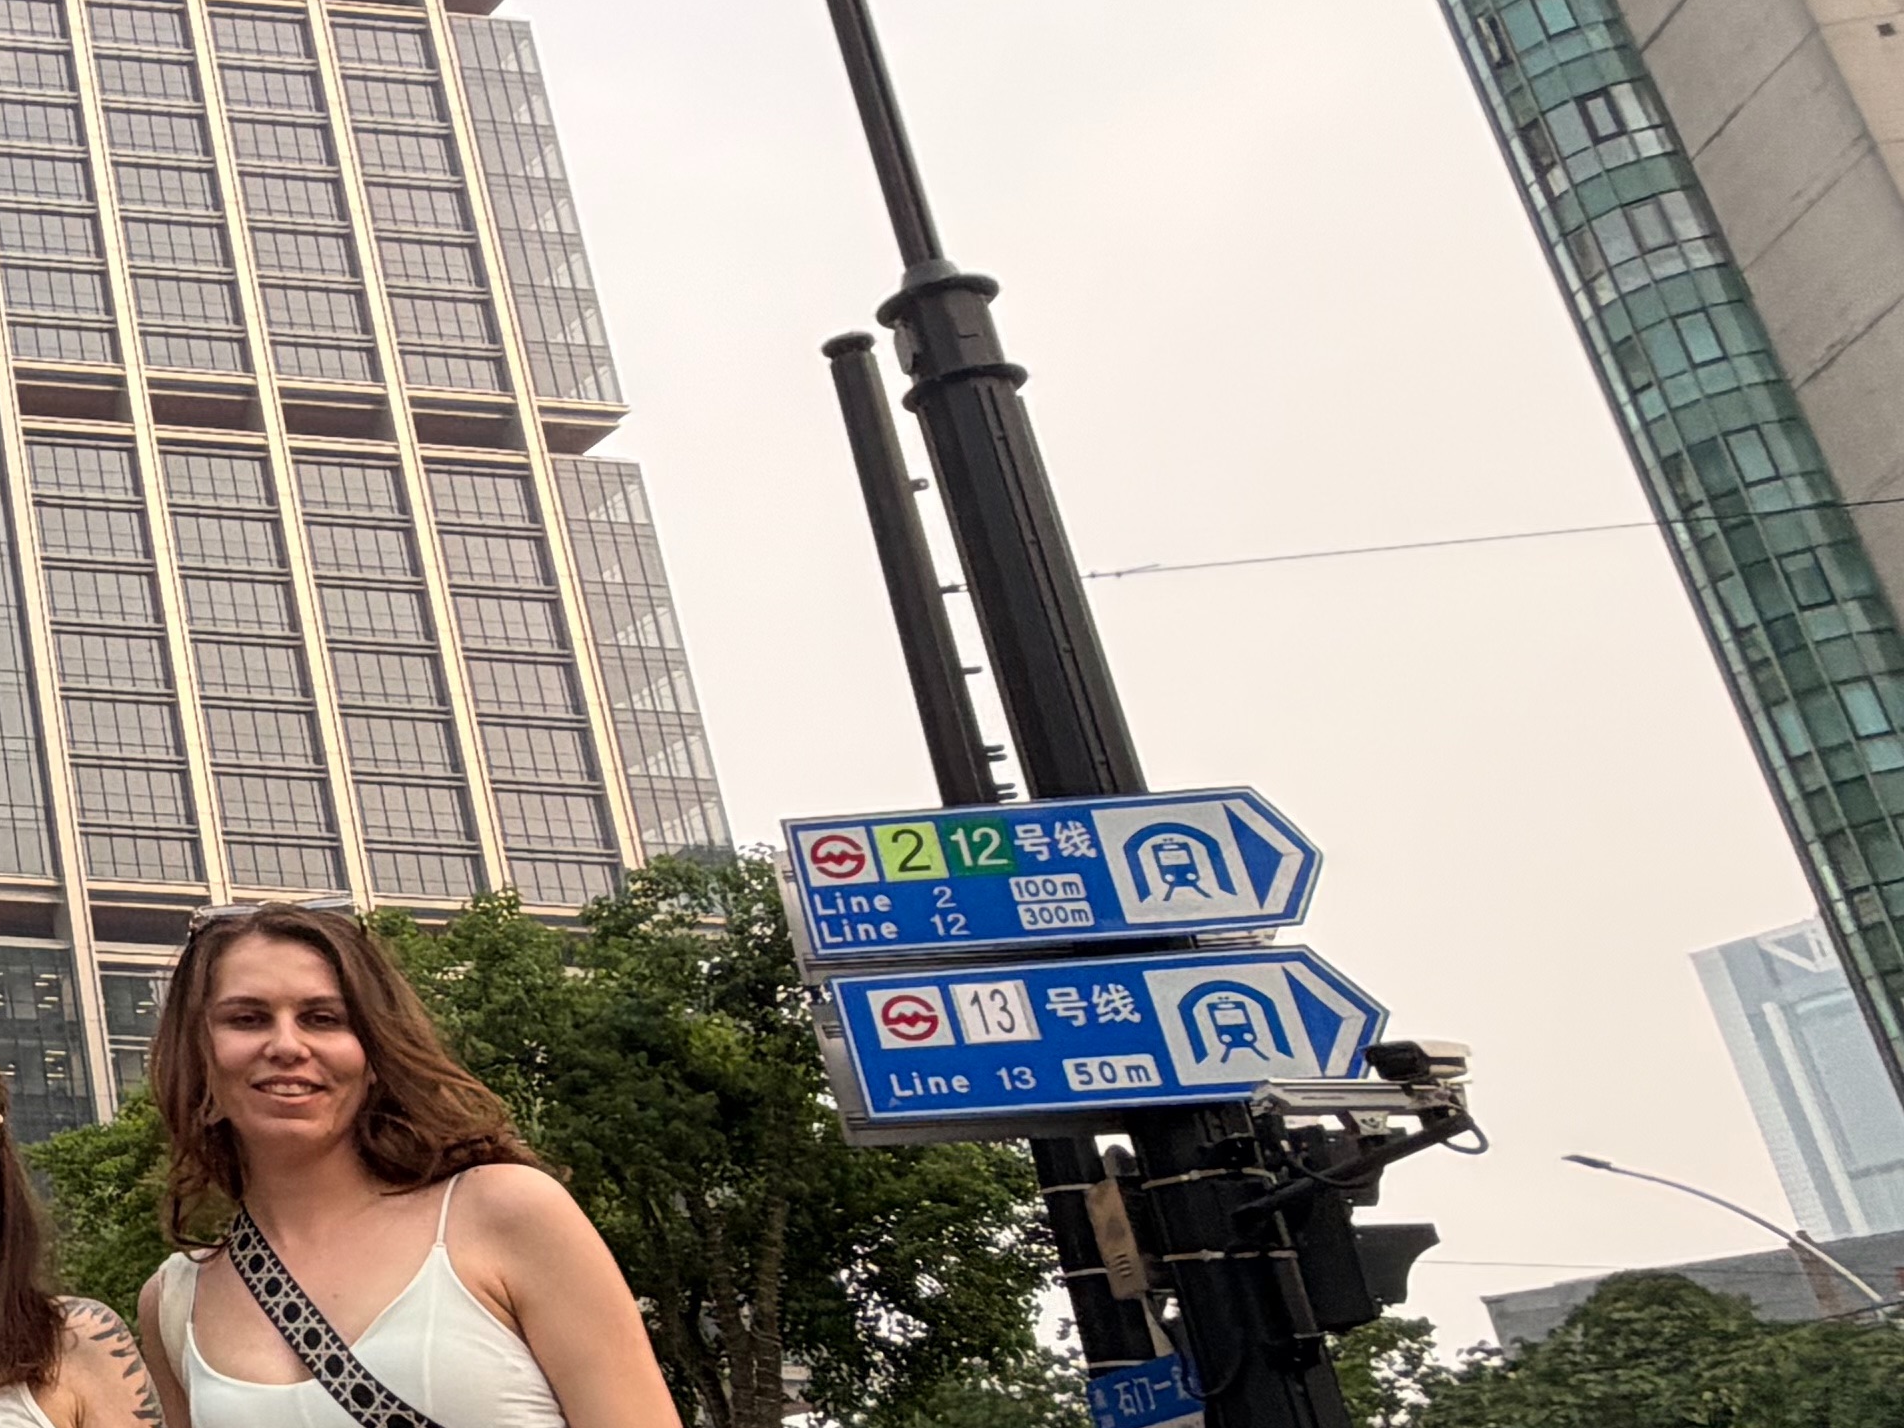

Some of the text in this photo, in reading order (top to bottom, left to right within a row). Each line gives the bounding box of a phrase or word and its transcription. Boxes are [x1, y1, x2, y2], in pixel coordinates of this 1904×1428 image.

[891, 820, 1098, 872] 2 12 号线
[813, 891, 893, 916] Line
[932, 886, 957, 909] 2
[819, 918, 899, 944] Line
[930, 913, 971, 937] 12
[969, 982, 1142, 1036] 13 号线
[889, 1071, 971, 1098] Line
[995, 1066, 1038, 1091] 13
